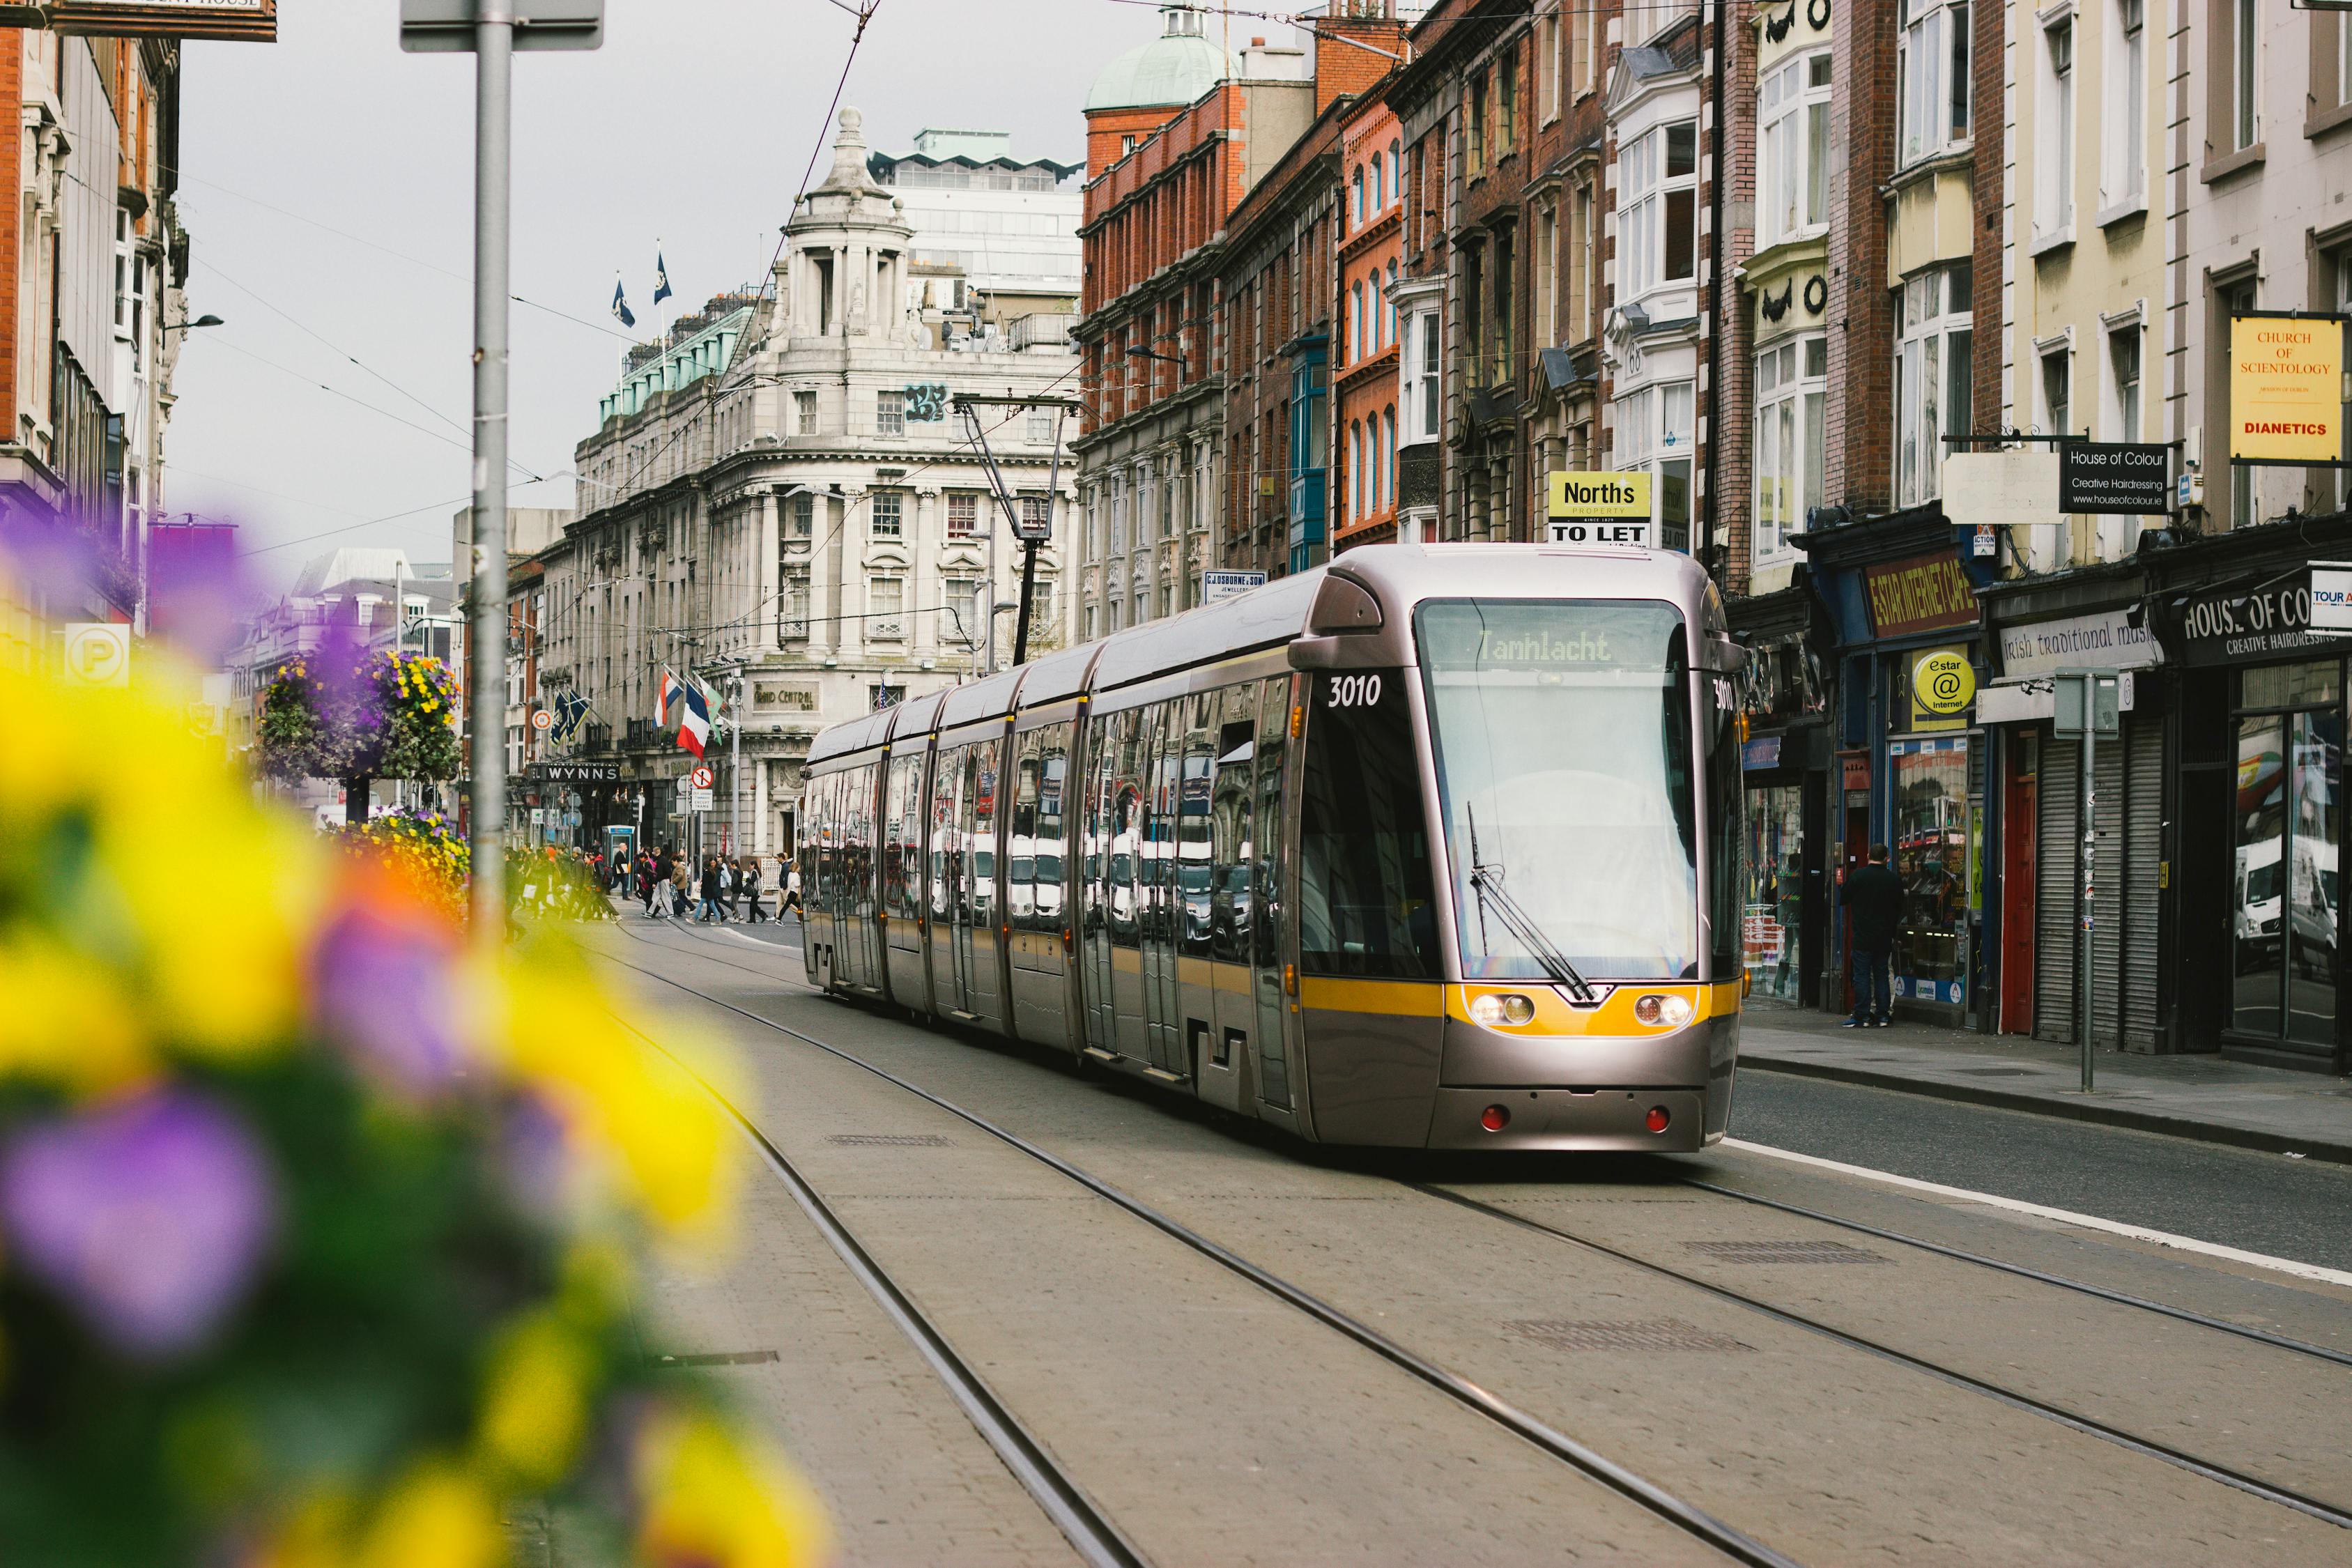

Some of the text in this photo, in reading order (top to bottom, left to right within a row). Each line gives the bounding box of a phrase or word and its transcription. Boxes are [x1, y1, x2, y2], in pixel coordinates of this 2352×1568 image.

[2258, 332, 2311, 344] CHURCH
[2276, 348, 2293, 358] OF
[2241, 362, 2330, 374] SCIENTOLOGY
[2245, 422, 2326, 436] DIANETICS
[2071, 452, 2163, 466] House of Colour
[2072, 478, 2162, 492] Creative Hairdressing
[1565, 482, 1635, 503] Norths
[2073, 494, 2162, 505] www.houseofcolour.ie
[1552, 526, 1645, 541] TO LET
[1250, 576, 1263, 585] SON
[1899, 562, 1947, 621] INTERNET
[2314, 591, 2344, 603] TOUR
[2250, 593, 2275, 631] OF
[1479, 630, 1612, 661] Tamhlacht
[2004, 633, 2033, 661] irish
[2038, 622, 2113, 656] traditional
[2227, 636, 2267, 655] CREATIVE
[778, 690, 813, 703] CENTRAL
[1328, 674, 1381, 708] 3010
[1712, 679, 1733, 711] 3010
[1933, 700, 1963, 709] Internet
[548, 767, 617, 780] WYNNS
